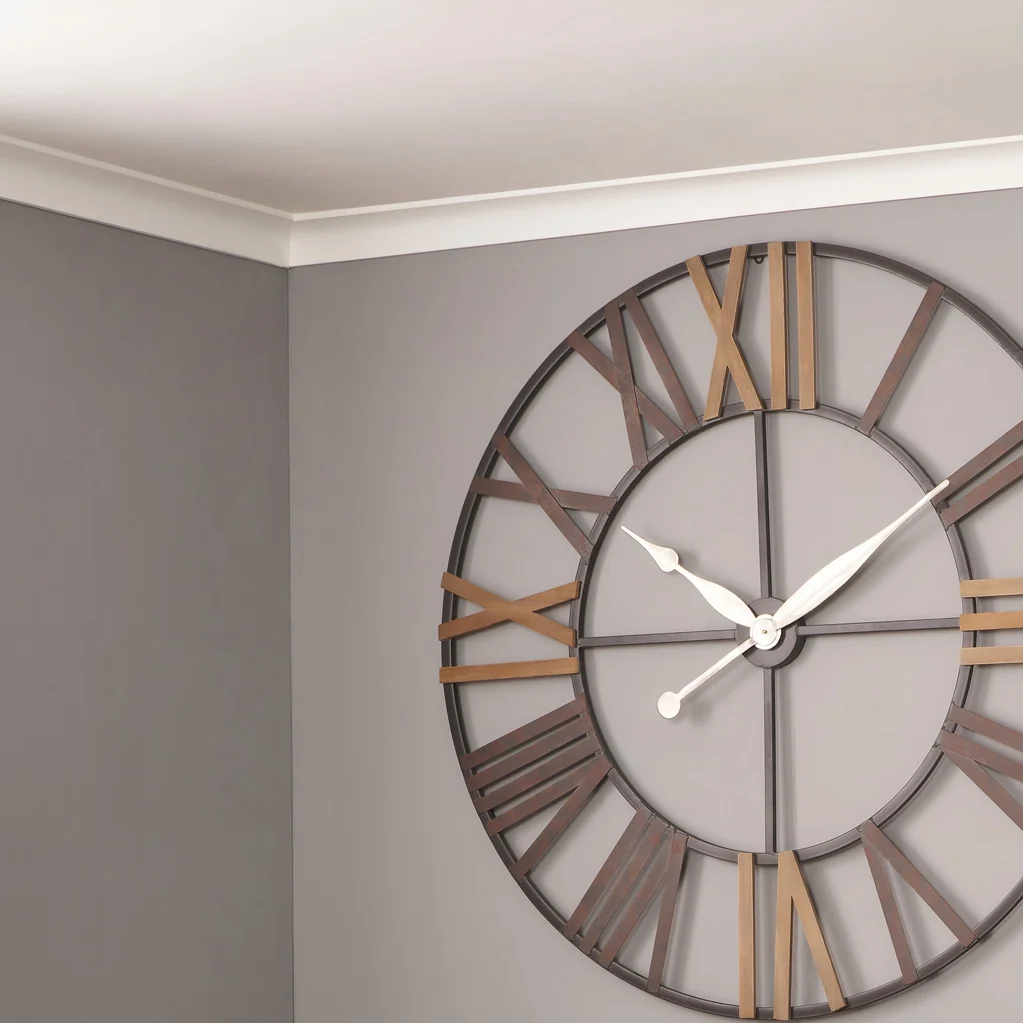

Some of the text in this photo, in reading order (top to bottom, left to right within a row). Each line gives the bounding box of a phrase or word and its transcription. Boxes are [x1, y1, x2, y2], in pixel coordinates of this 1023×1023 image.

[567, 289, 701, 472] XI
[686, 241, 816, 421] XII
[857, 282, 945, 436] I
[471, 432, 619, 564] X
[439, 572, 581, 683] IX
[737, 850, 847, 1021] VI
[859, 819, 979, 987] V
